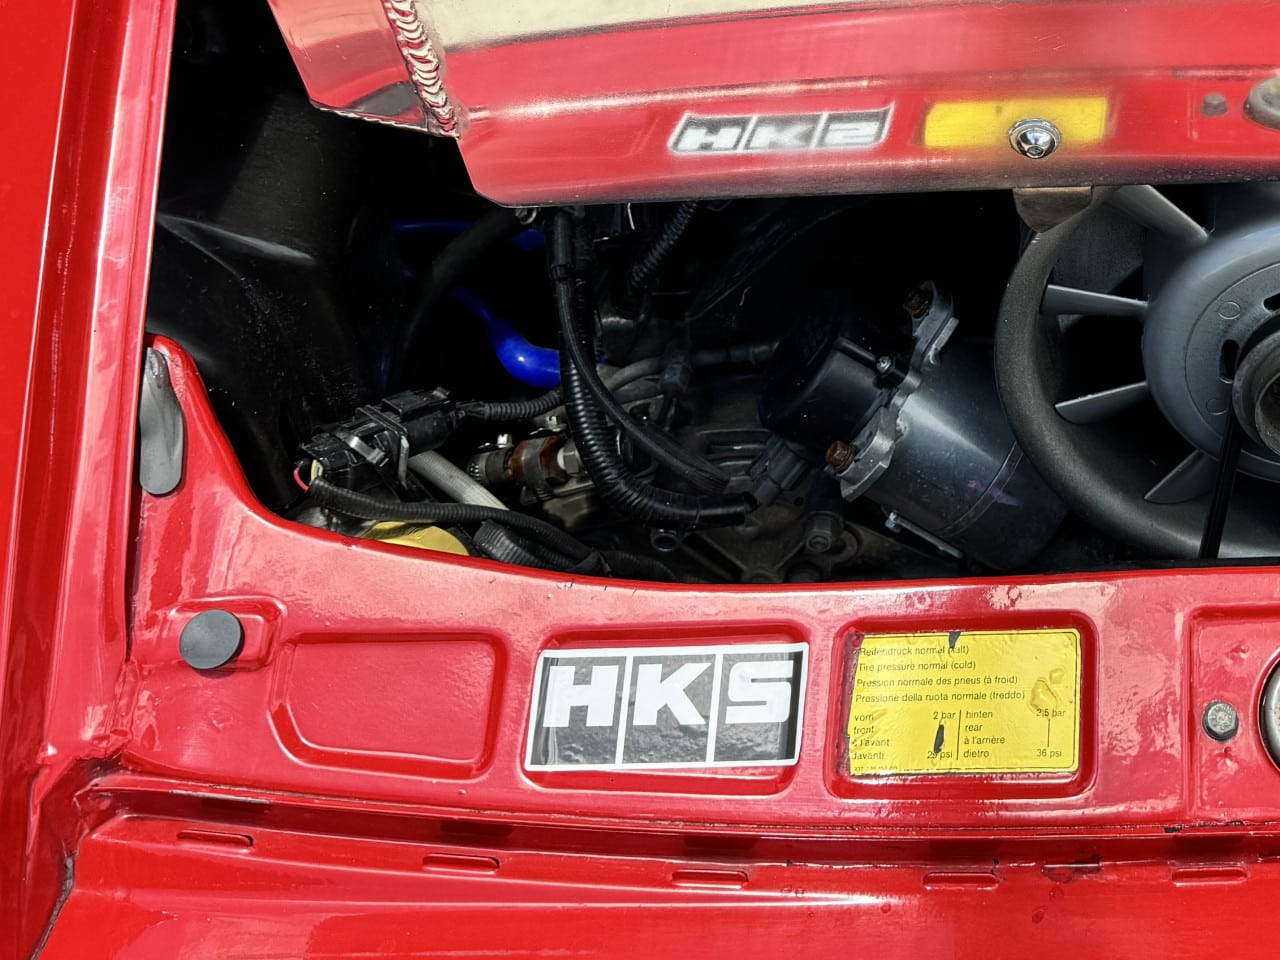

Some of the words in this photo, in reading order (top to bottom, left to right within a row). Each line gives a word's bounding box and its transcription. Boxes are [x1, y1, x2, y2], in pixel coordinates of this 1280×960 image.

[859, 663, 874, 671] Tire
[877, 662, 915, 672] pressure
[918, 661, 948, 670] normal
[951, 661, 976, 670] (cold)
[856, 678, 894, 687] Pression
[897, 677, 934, 686] normale
[936, 677, 951, 686] des
[954, 677, 981, 687] pneus
[994, 675, 1018, 685] froid)
[542, 660, 794, 727] HKS
[855, 694, 899, 703] Pressione
[902, 693, 923, 702] della
[925, 693, 949, 701] ruota
[951, 692, 987, 701] normale
[989, 691, 1025, 700] (freddo)
[933, 711, 939, 719] 2
[941, 711, 956, 719] bar
[965, 710, 993, 719] hinten
[1051, 708, 1066, 717] bar
[853, 726, 874, 734] front
[965, 724, 983, 732] rear
[964, 736, 970, 745] à
[972, 735, 1005, 745] l'arrière
[940, 751, 953, 760] psi
[963, 749, 990, 758] dietro
[1036, 748, 1047, 757] 36
[1049, 749, 1062, 759] psi
